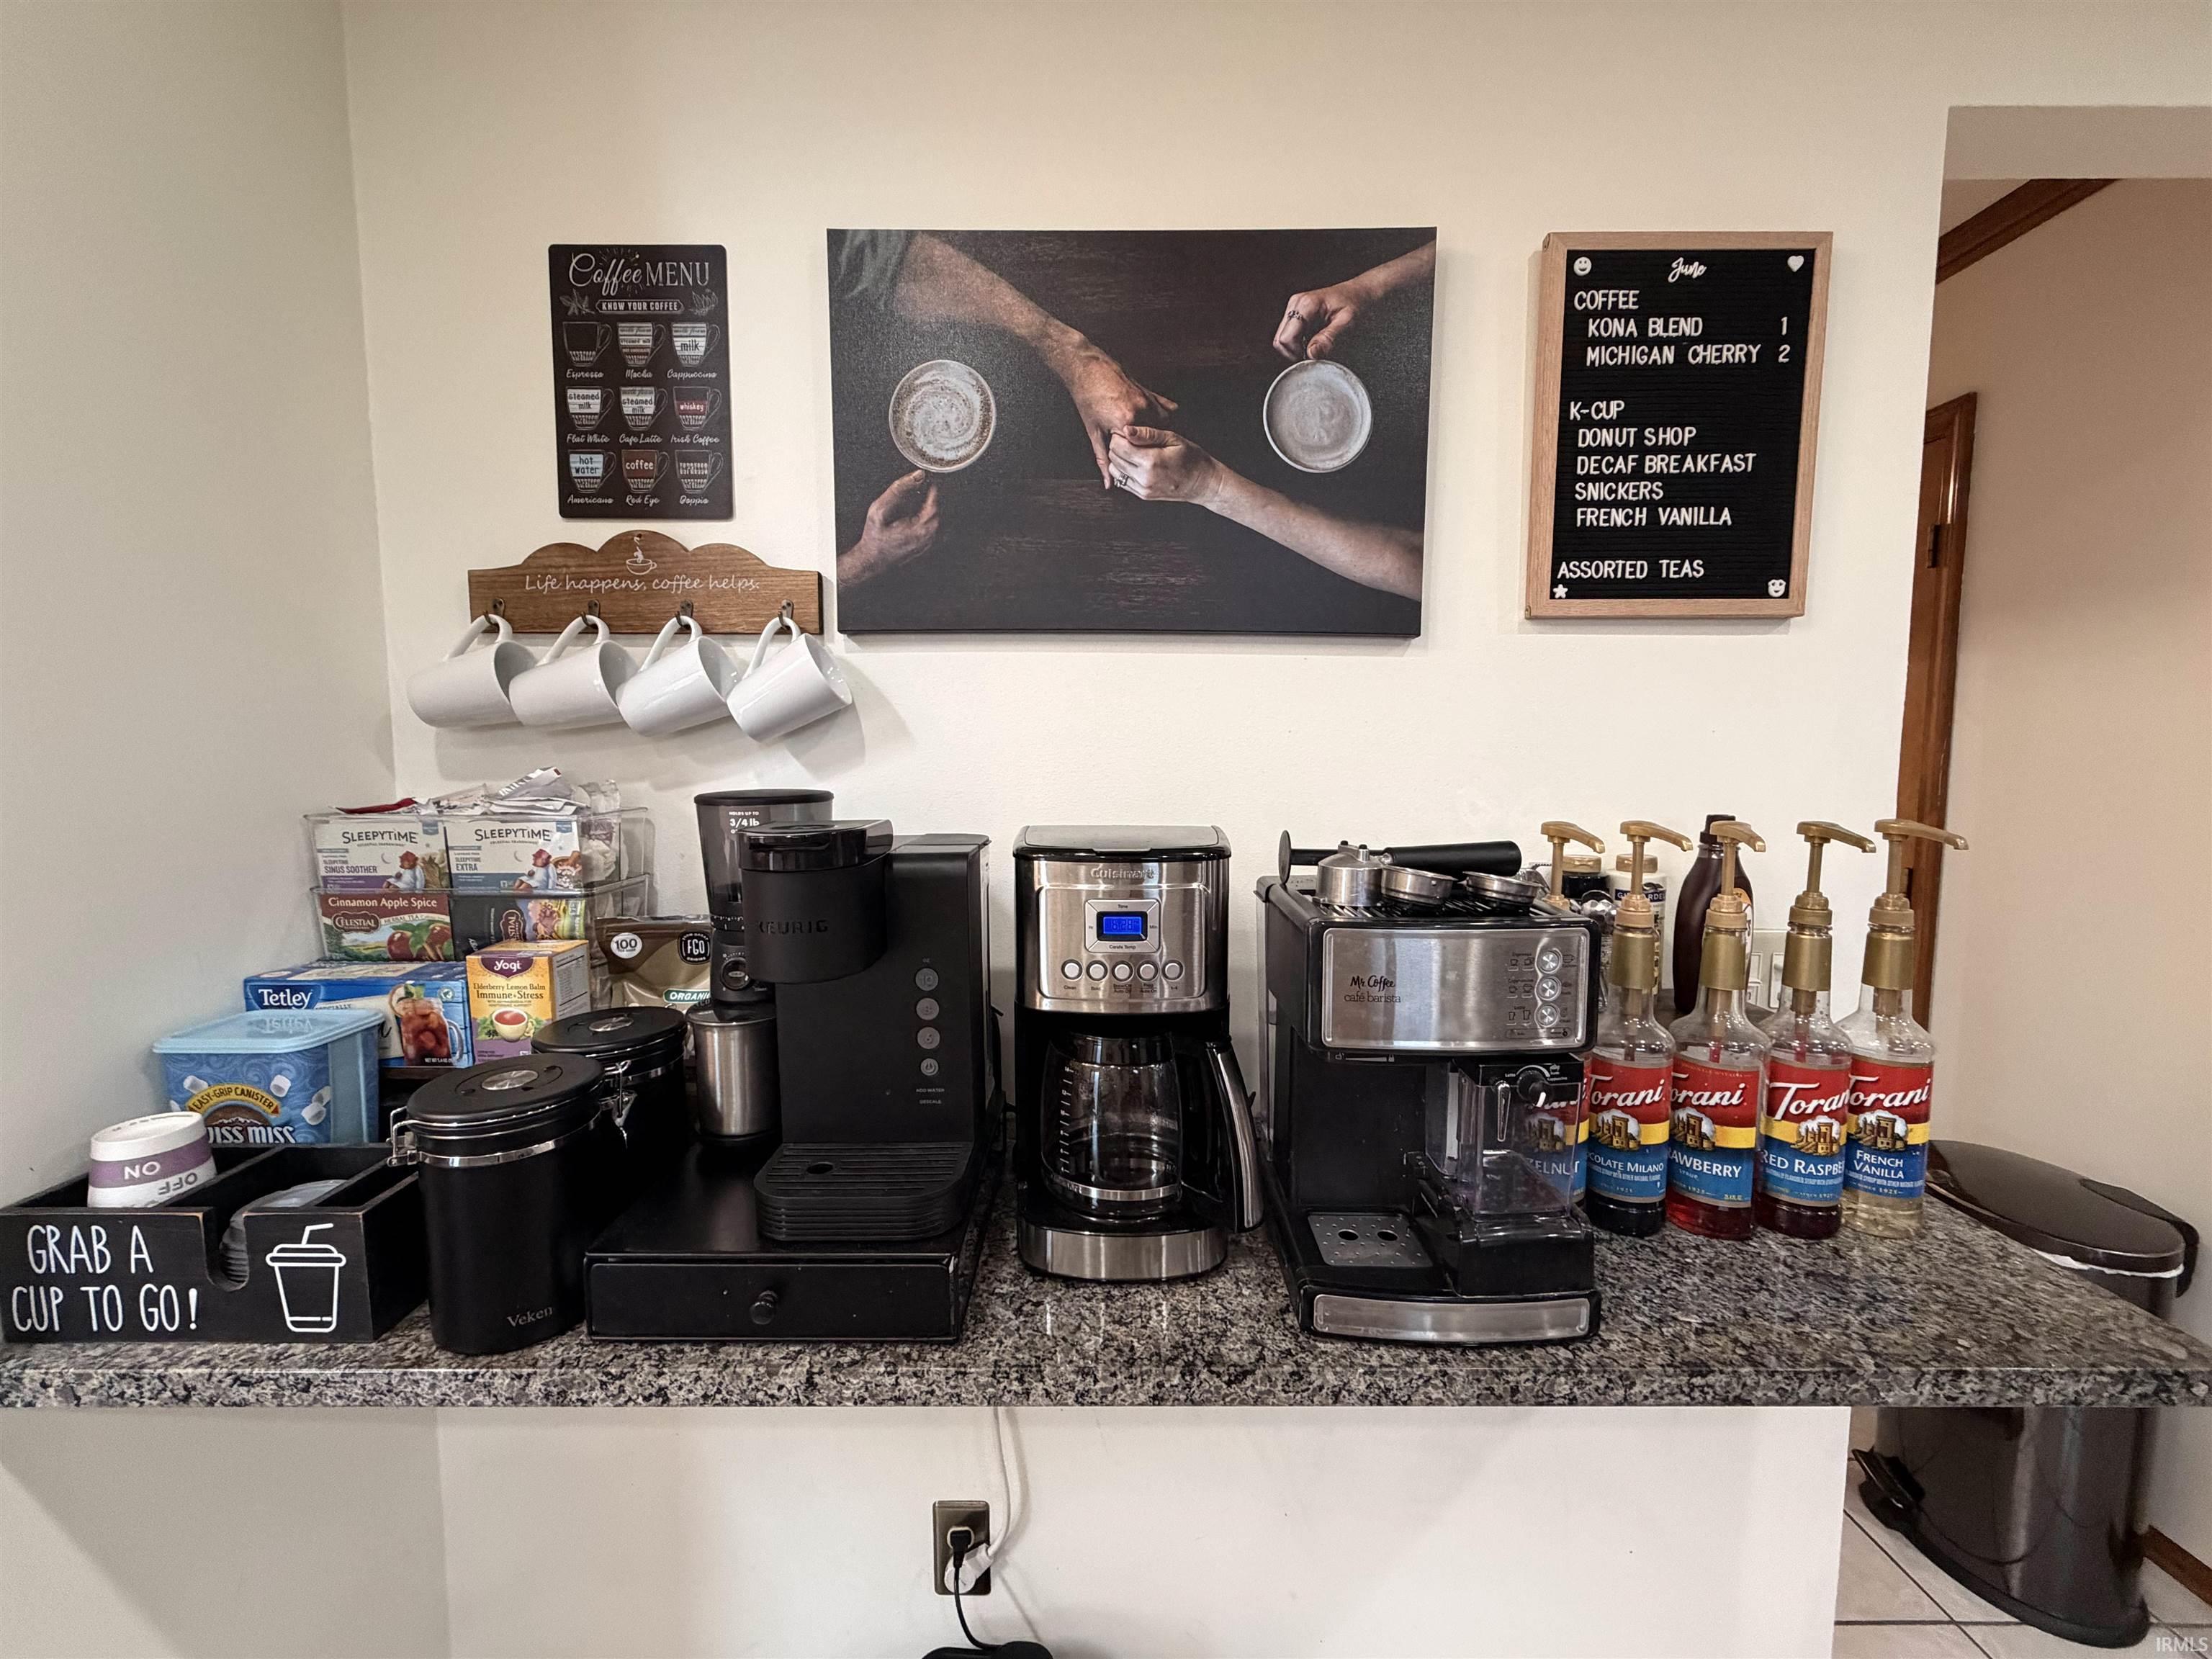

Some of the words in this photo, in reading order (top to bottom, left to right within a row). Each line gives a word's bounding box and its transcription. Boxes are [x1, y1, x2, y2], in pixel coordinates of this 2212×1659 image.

[569, 253, 642, 296] Coffee
[646, 262, 709, 287] MENU
[1668, 257, 1707, 283] June
[602, 302, 625, 311] KNOW
[649, 302, 678, 311] COFFEE
[1574, 290, 1639, 310] COFFEE
[1588, 318, 1637, 338] KONA
[1648, 317, 1703, 337] BLEND
[1781, 316, 1788, 336] 1
[680, 340, 700, 353] milk
[1586, 346, 1675, 367] MICHIGAN
[1688, 344, 1762, 365] CHERRY
[1778, 344, 1791, 363] 2
[566, 369, 605, 379] Espresso
[625, 369, 653, 379] Mocha
[667, 369, 718, 380] Cappuccino
[569, 390, 600, 401] steamed
[622, 396, 653, 406] steamed
[578, 402, 592, 410] milk
[680, 403, 704, 413] whiskey
[1570, 400, 1624, 421] K-CUP
[567, 433, 585, 444] Flat
[585, 433, 610, 444] White
[619, 433, 639, 444] Cafe
[639, 433, 662, 444] Latte
[670, 433, 691, 444] Irish
[693, 434, 720, 446] Coffee
[1578, 427, 1638, 447] DONUT
[1644, 426, 1696, 446] SHOP
[579, 456, 593, 465] hot
[625, 459, 654, 470] coffee
[1576, 454, 1639, 476] DECAF
[1644, 453, 1757, 474] BREAKFAST
[575, 465, 600, 475] water
[1575, 481, 1664, 501] SNICKERS
[567, 495, 614, 504] Americano
[626, 495, 642, 505] Red
[644, 495, 660, 507] Eye
[679, 495, 709, 506] Doppio
[1576, 508, 1647, 527] FRENCH
[1658, 506, 1732, 526] VANILLA
[1556, 560, 1648, 579] ASSORTED
[1659, 559, 1704, 578] TEAS
[525, 575, 562, 595] Life
[565, 575, 647, 595] happens,
[652, 575, 703, 595] coffee
[729, 817, 748, 828] 3/4
[750, 818, 760, 827] lb
[324, 866, 346, 874] SINUS
[346, 866, 378, 874] SOOTHER
[1091, 867, 1155, 879] Cuisinart
[328, 896, 378, 908] Cinnamon
[380, 897, 409, 909] Apple
[411, 897, 438, 909] Spice
[614, 938, 638, 949] 100
[687, 939, 705, 956] FGO
[473, 982, 505, 991] Elderberry
[1367, 975, 1395, 992] Coffee
[258, 988, 313, 1010] Tetley
[477, 990, 513, 999] Immune
[1344, 990, 1365, 1002] café
[1367, 990, 1401, 1003] barista
[193, 1087, 233, 1110] EASY-GRIP
[234, 1087, 275, 1110] CANISTER
[1769, 1082, 1851, 1120] Toran
[248, 1125, 297, 1144] MISS
[1760, 1149, 1789, 1169] RED
[1856, 1149, 1904, 1168] FRENCH
[1627, 1161, 1664, 1173] MILANO
[1853, 1160, 1905, 1179] VANILLA
[27, 1225, 112, 1274] GRAB
[130, 1225, 154, 1274] A
[12, 1285, 63, 1333] CUP
[80, 1285, 124, 1333] TO
[140, 1283, 198, 1333] GO!
[507, 1307, 553, 1327] Veken
